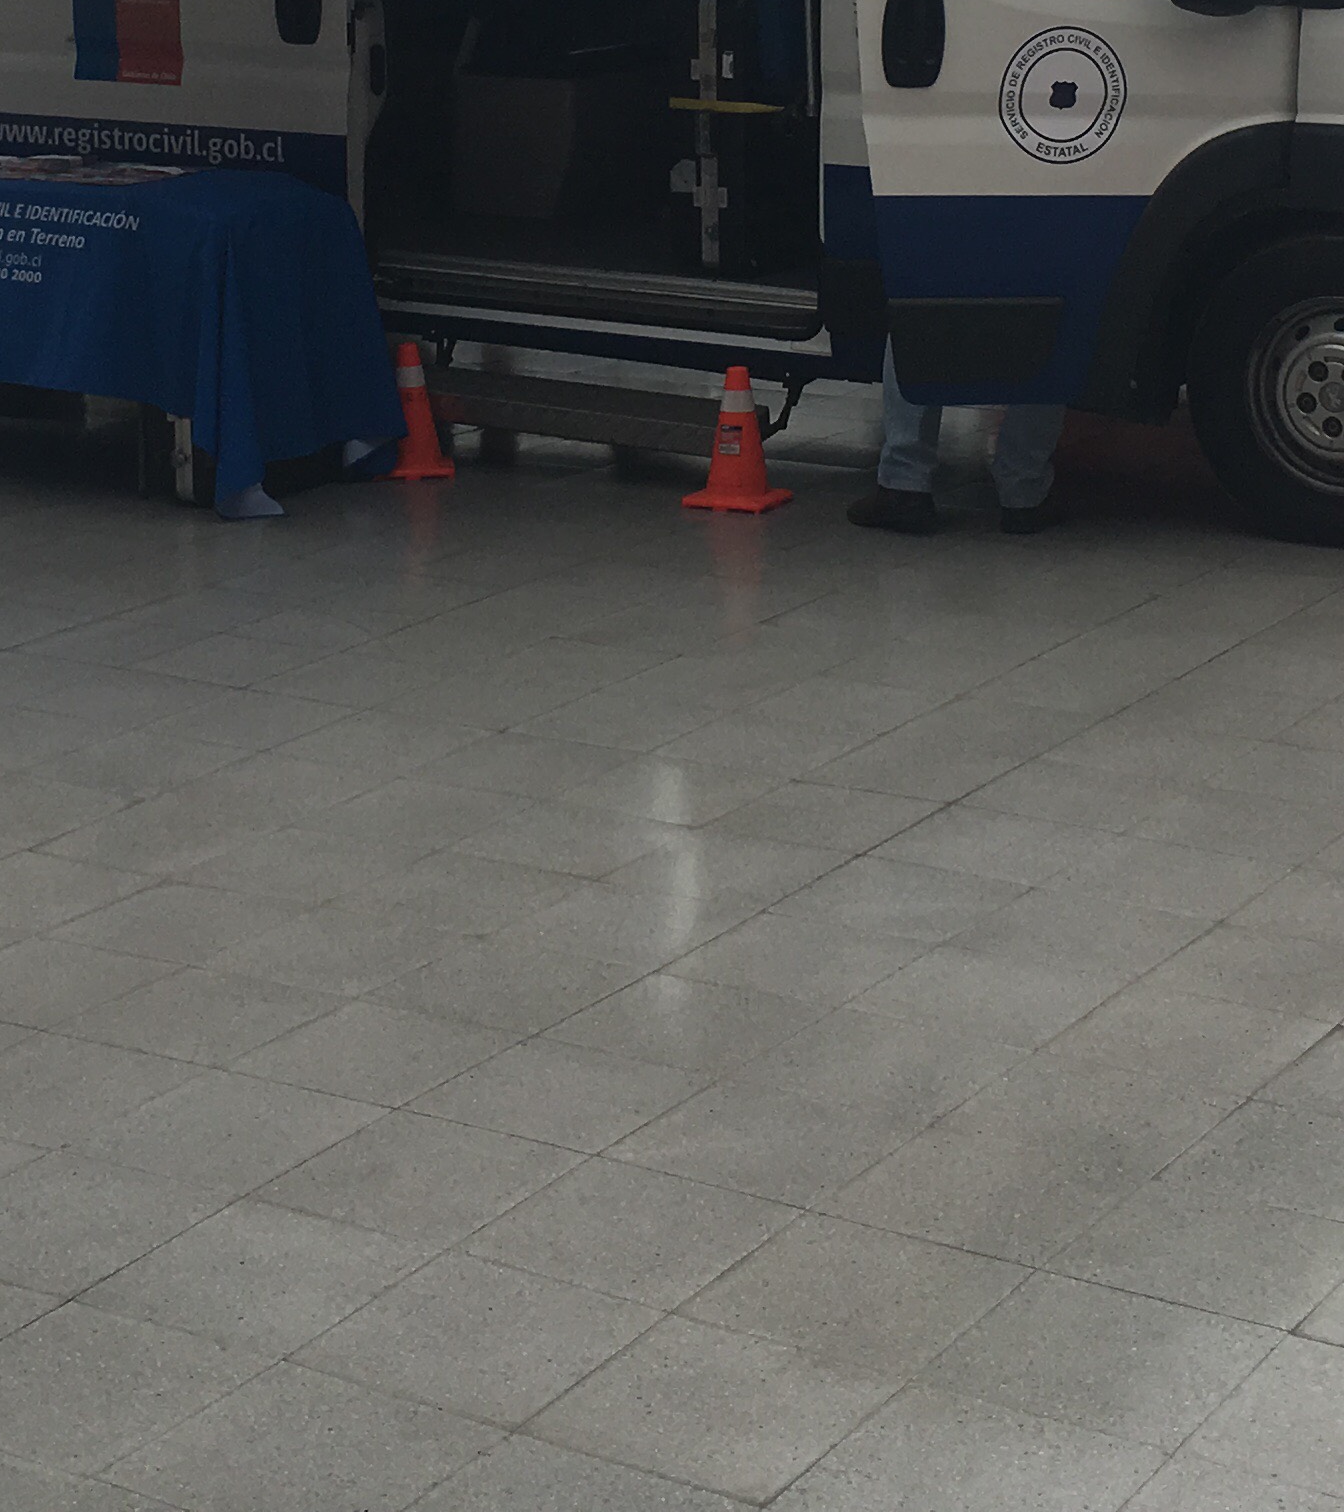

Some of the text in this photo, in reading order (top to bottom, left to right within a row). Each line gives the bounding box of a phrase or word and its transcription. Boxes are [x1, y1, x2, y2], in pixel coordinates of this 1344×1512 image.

[1067, 34, 1091, 50] CIVIL
[1093, 45, 1102, 56] E
[1016, 34, 1065, 70] REGISTRO
[1009, 71, 1020, 87] DE
[1006, 90, 1028, 139] SERVICIO
[1035, 141, 1089, 158] ESTATAL
[14, 203, 24, 218] E
[25, 204, 140, 231] IDENTIFICACIÓN
[7, 229, 26, 243] en
[29, 228, 85, 249] Terreno
[11, 269, 42, 283] 2000
